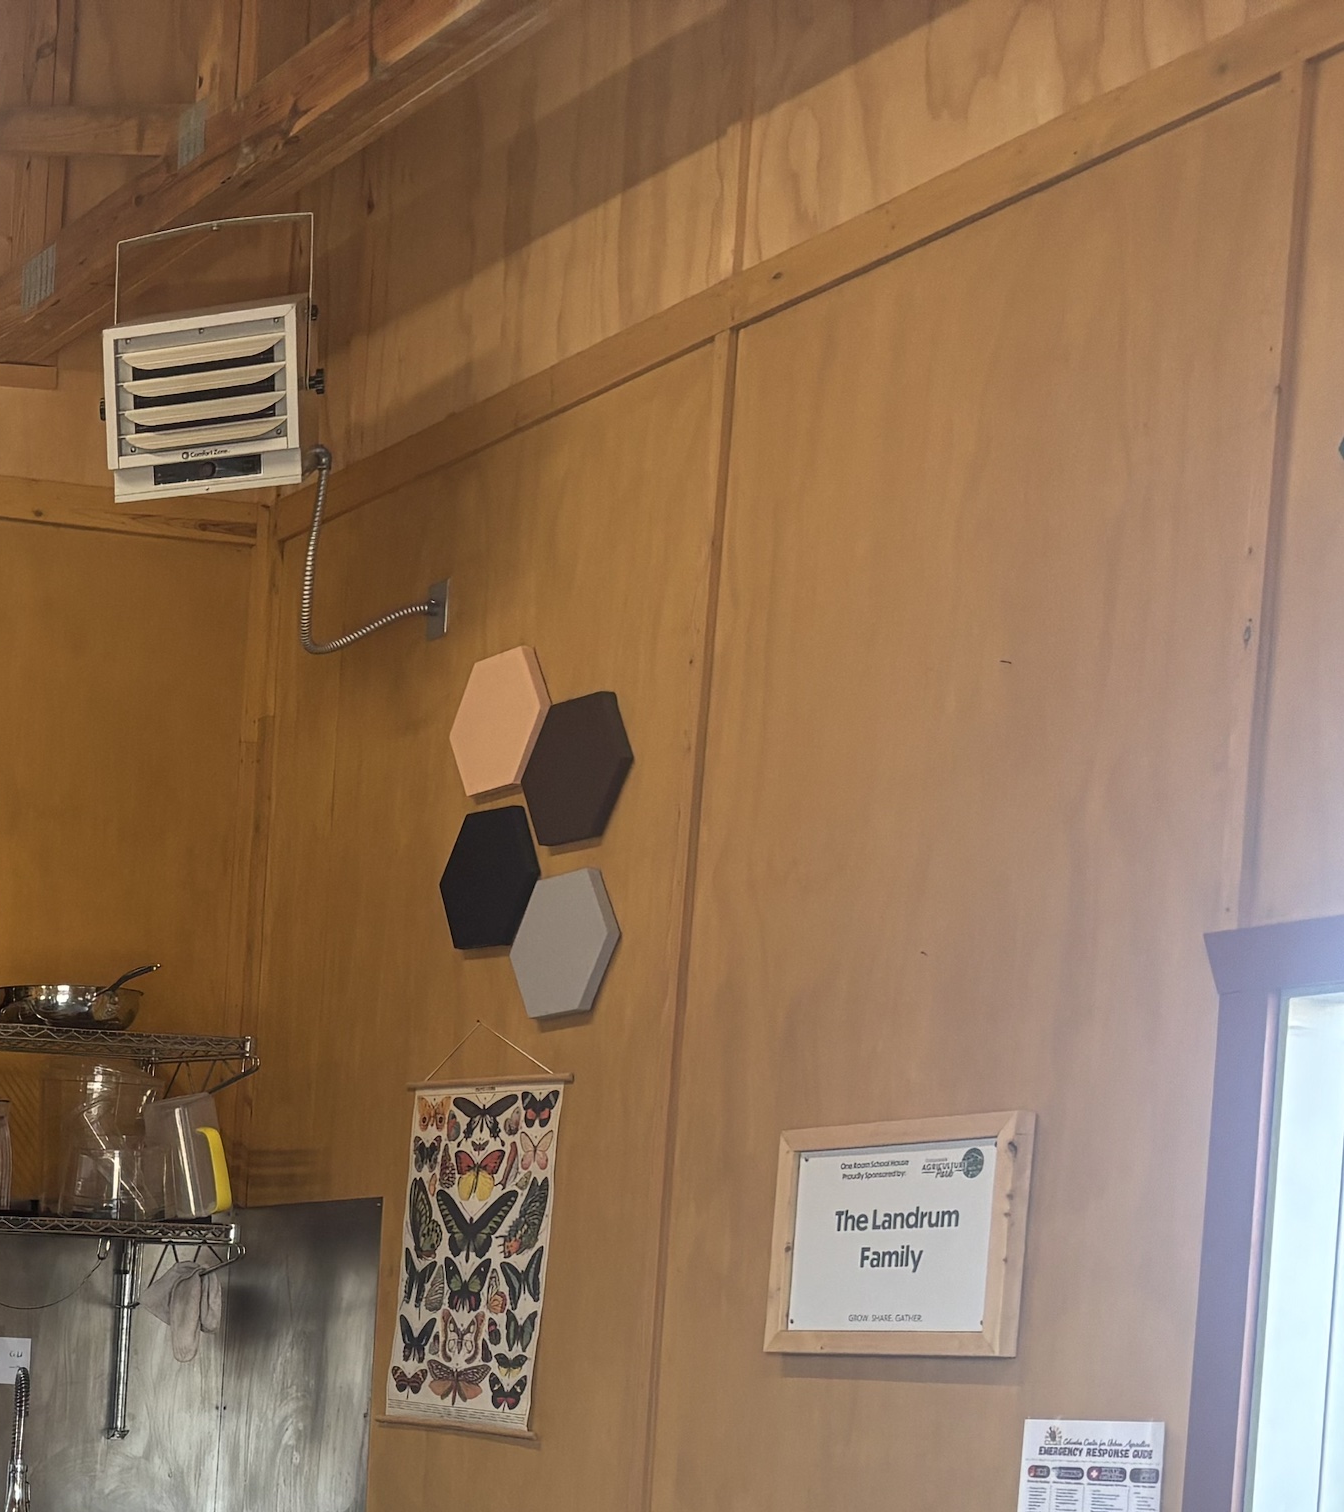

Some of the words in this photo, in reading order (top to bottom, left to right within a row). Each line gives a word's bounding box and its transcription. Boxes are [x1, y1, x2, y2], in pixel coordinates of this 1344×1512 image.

[840, 1162, 853, 1171] One
[835, 1209, 869, 1232] The
[871, 1206, 960, 1231] Landrum
[859, 1244, 924, 1273] Family
[1038, 1446, 1084, 1457] EMERGENCY
[1085, 1448, 1130, 1458] RESPONSE
